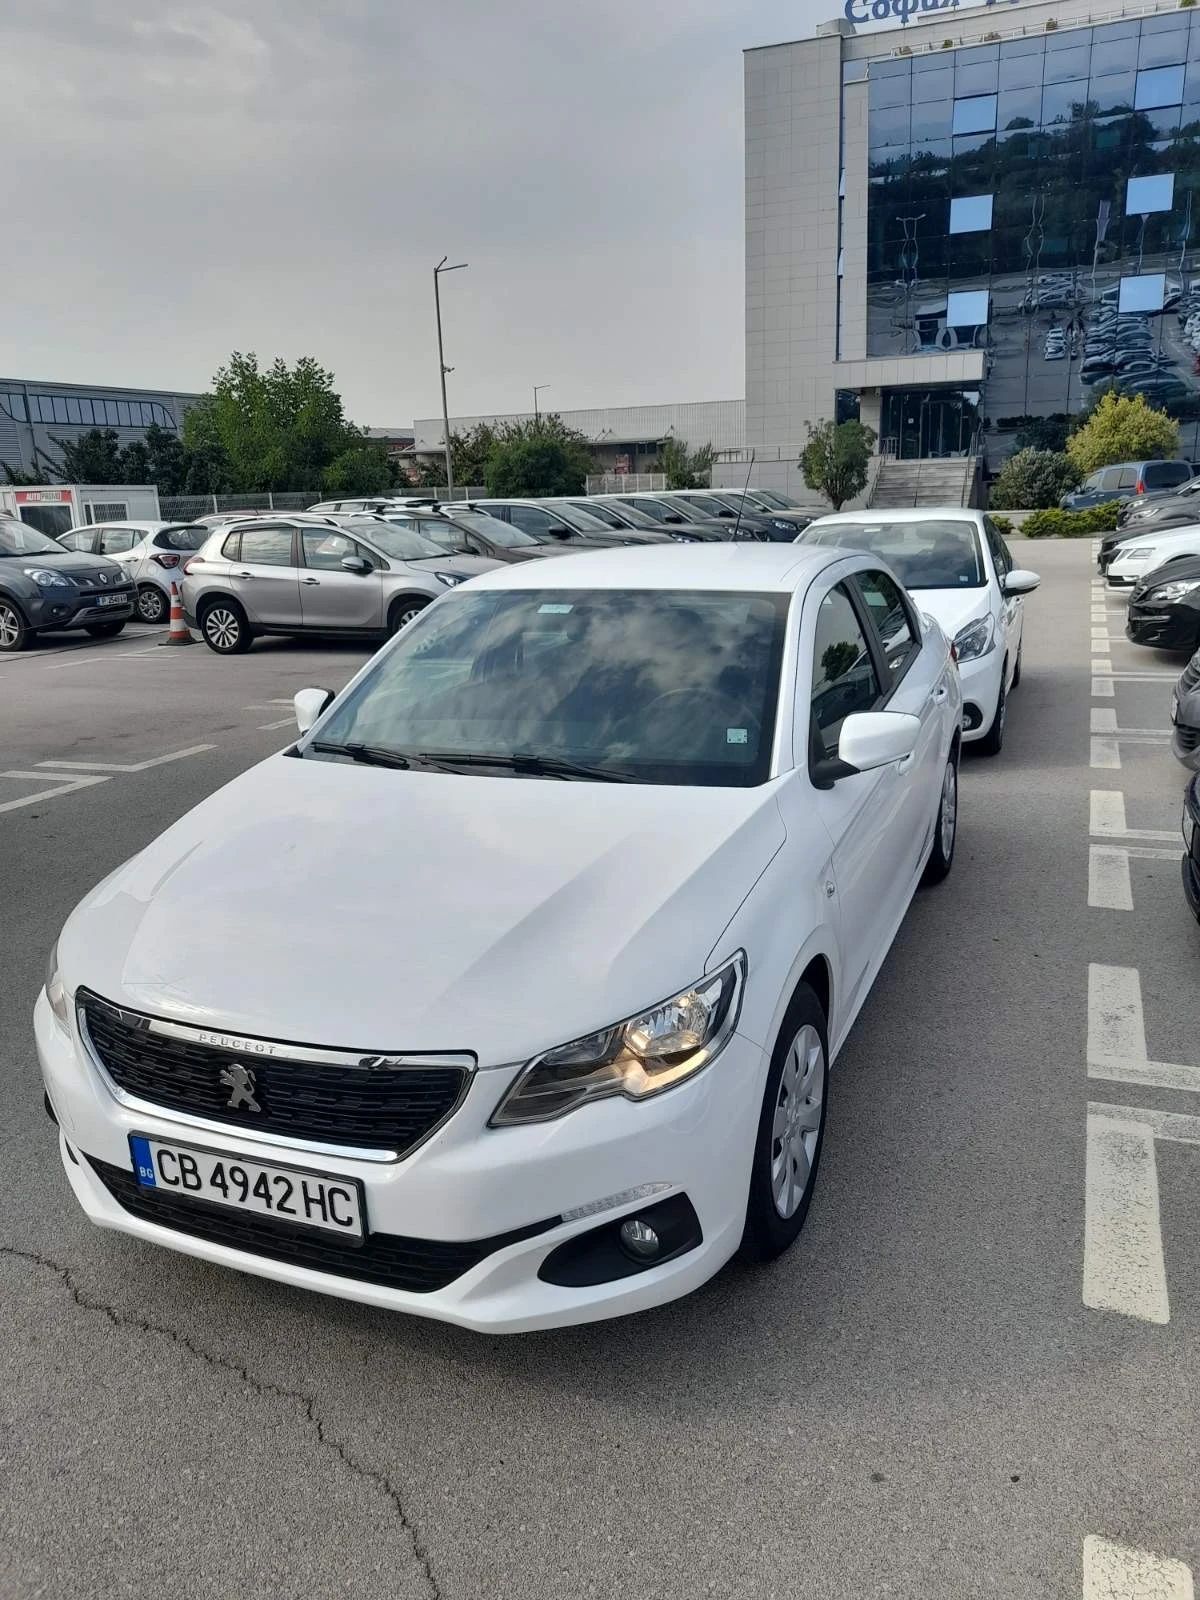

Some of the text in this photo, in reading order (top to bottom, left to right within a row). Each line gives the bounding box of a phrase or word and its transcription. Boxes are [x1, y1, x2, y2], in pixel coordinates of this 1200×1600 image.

[139, 1166, 153, 1178] BG
[156, 1149, 353, 1227] CB 4942 HC
